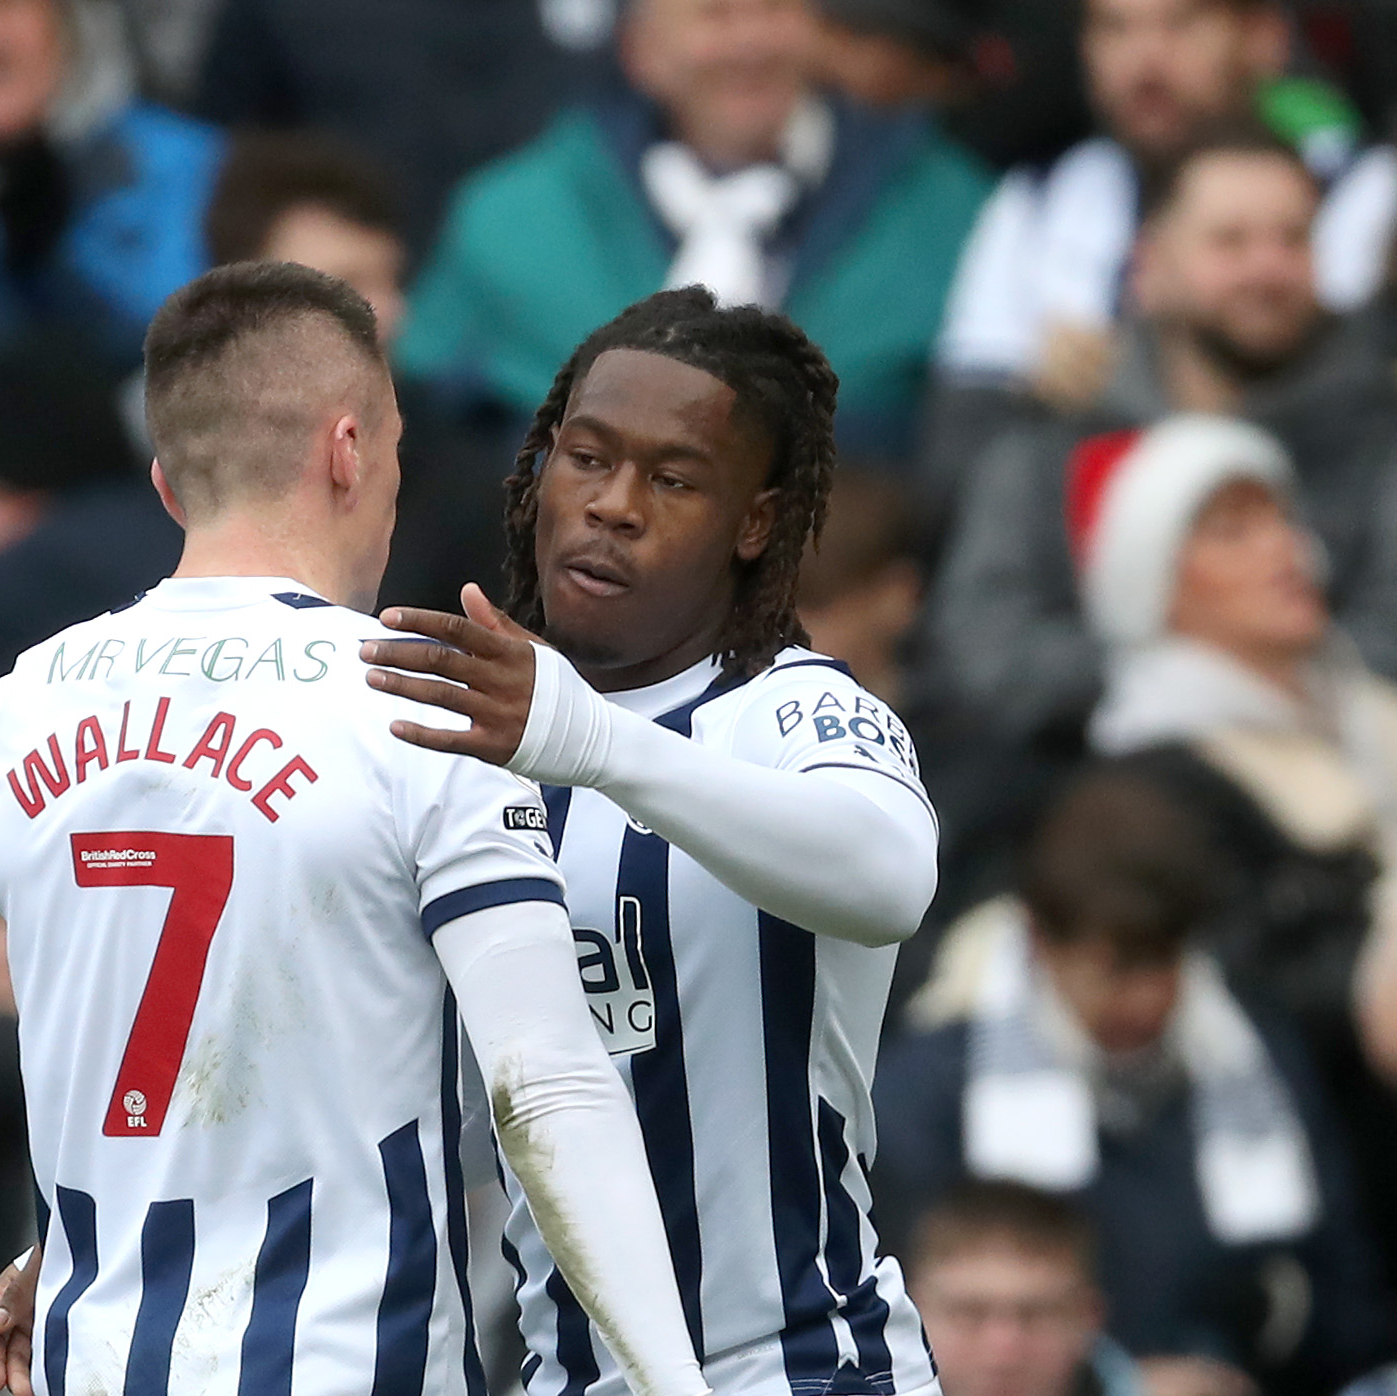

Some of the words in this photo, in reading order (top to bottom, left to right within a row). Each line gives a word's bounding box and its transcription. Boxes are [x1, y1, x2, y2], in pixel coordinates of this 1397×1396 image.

[135, 636, 337, 682] VEGAS
[6, 696, 319, 824] WALLACE
[572, 896, 650, 994] al
[70, 832, 234, 1137] 7
[589, 1000, 653, 1035] NG
[127, 1116, 148, 1128] EFL
